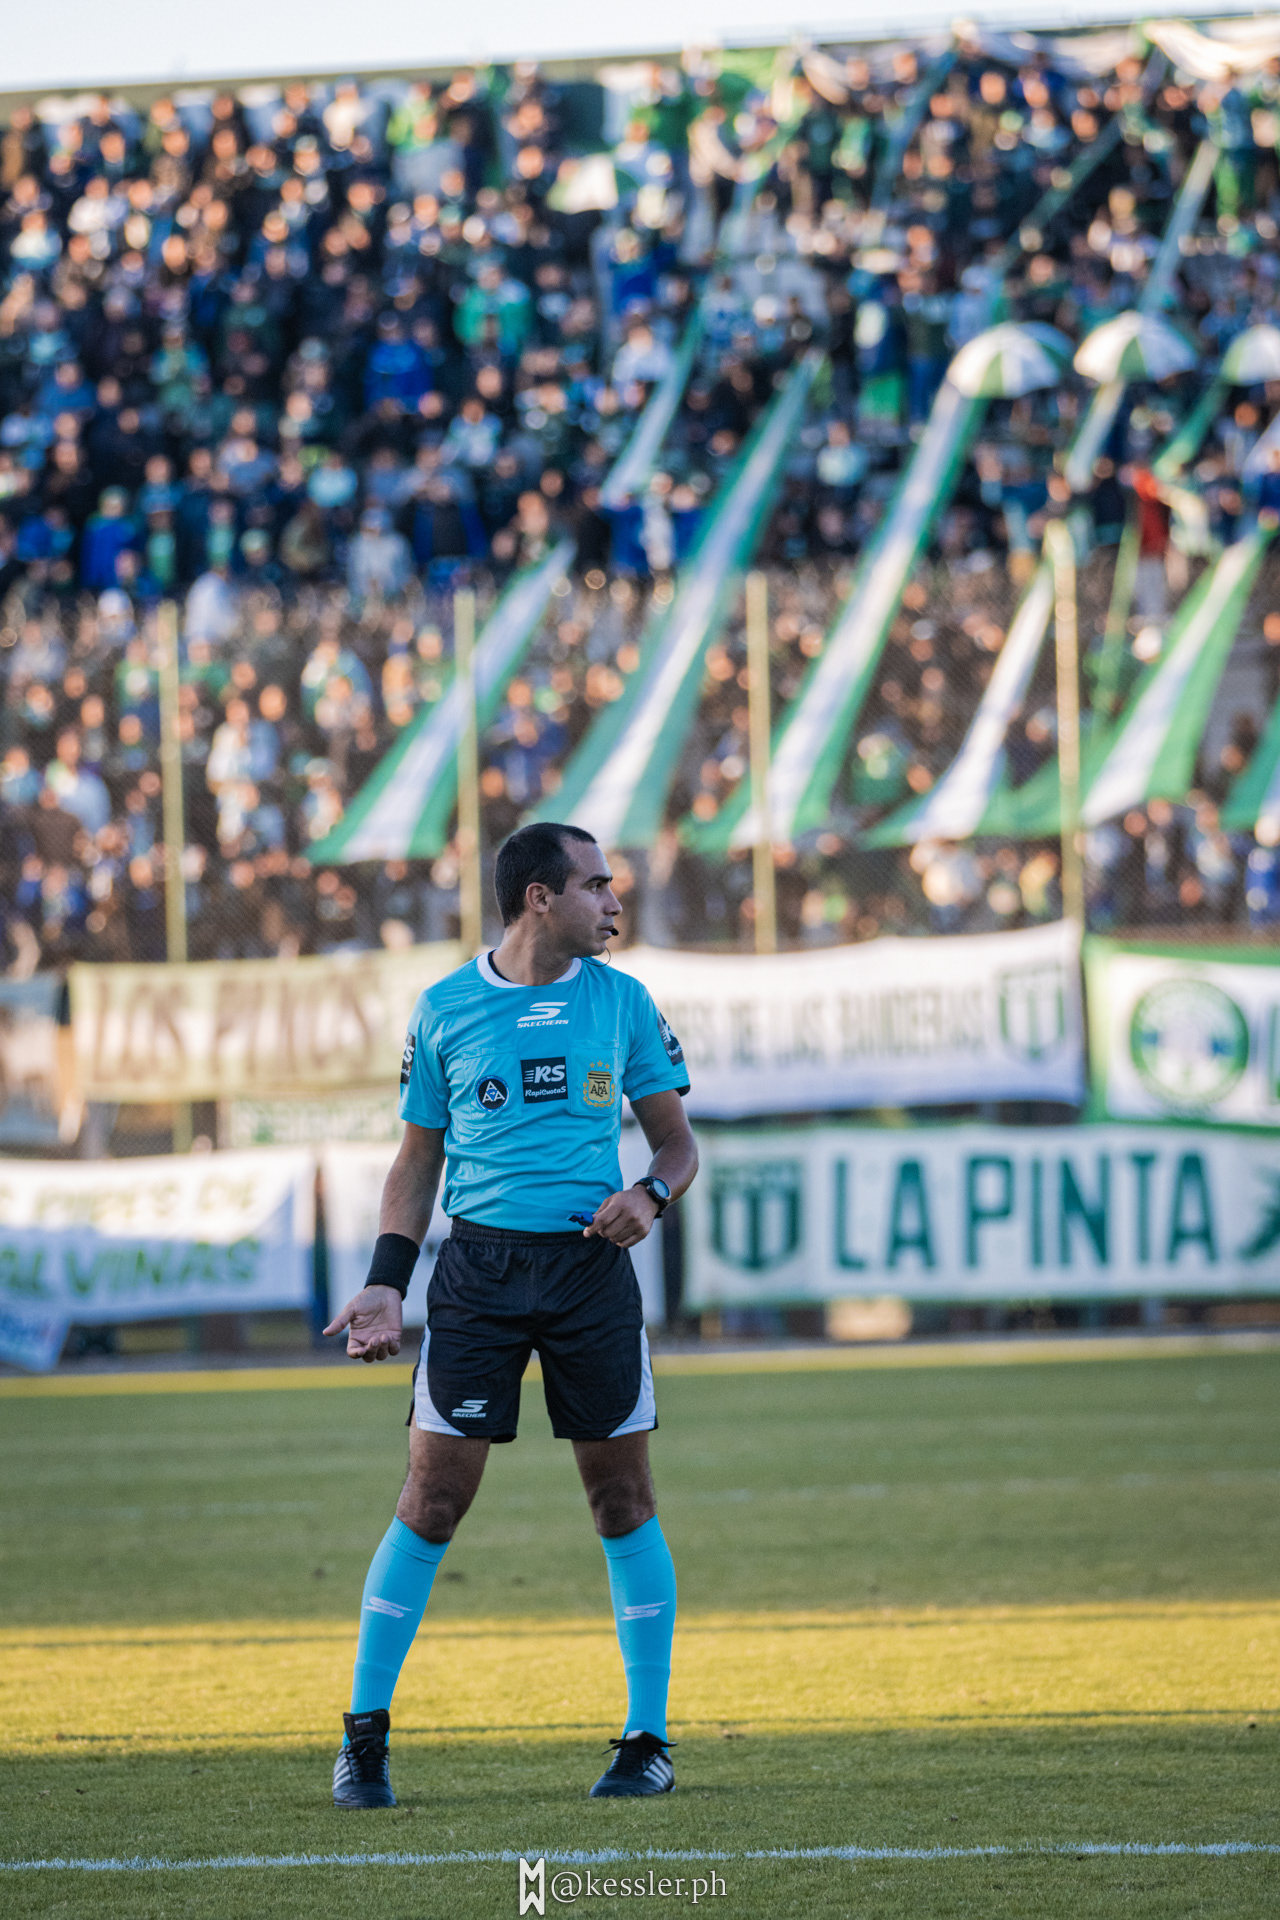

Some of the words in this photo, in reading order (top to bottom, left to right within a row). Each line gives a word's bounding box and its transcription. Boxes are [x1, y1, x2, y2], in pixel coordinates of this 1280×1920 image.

[517, 1019, 569, 1028] SKECHERS
[833, 1150, 937, 1271] LA
[963, 1149, 1220, 1269] PINTA
